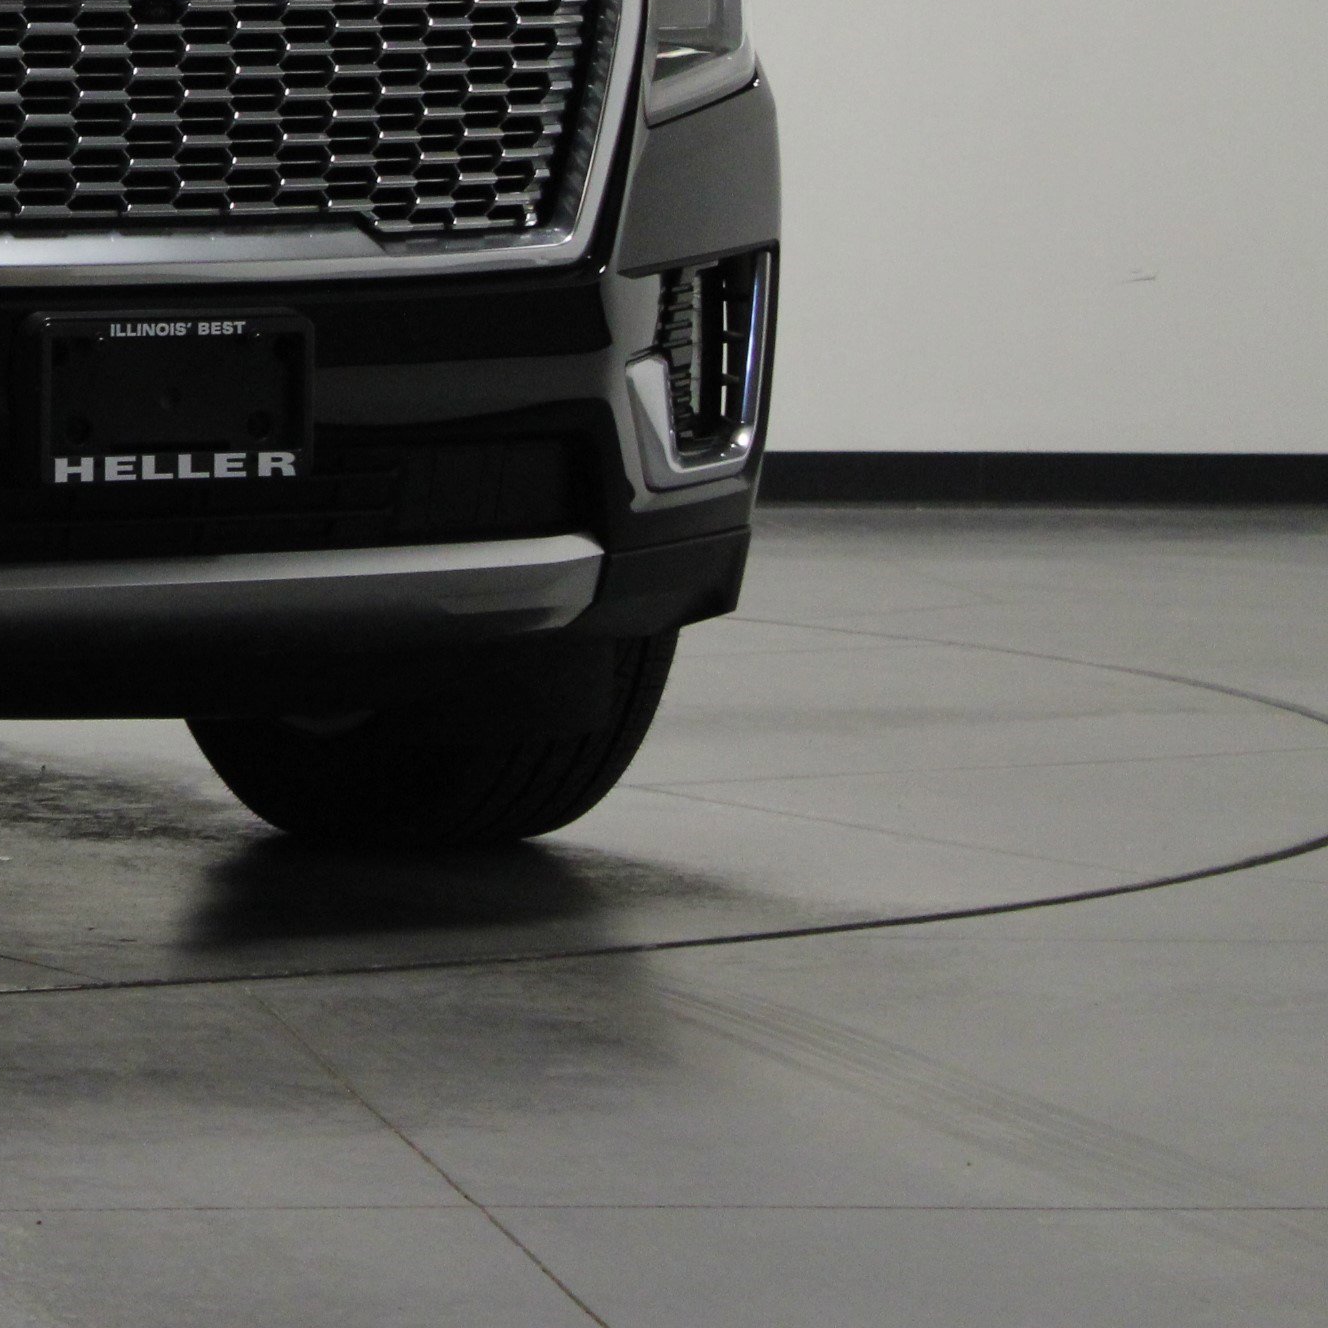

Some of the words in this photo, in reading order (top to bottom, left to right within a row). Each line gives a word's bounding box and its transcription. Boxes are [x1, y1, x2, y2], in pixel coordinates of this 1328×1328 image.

[109, 322, 193, 338] ILLINOIS'
[197, 321, 247, 336] BEST
[53, 451, 297, 484] HELLER
